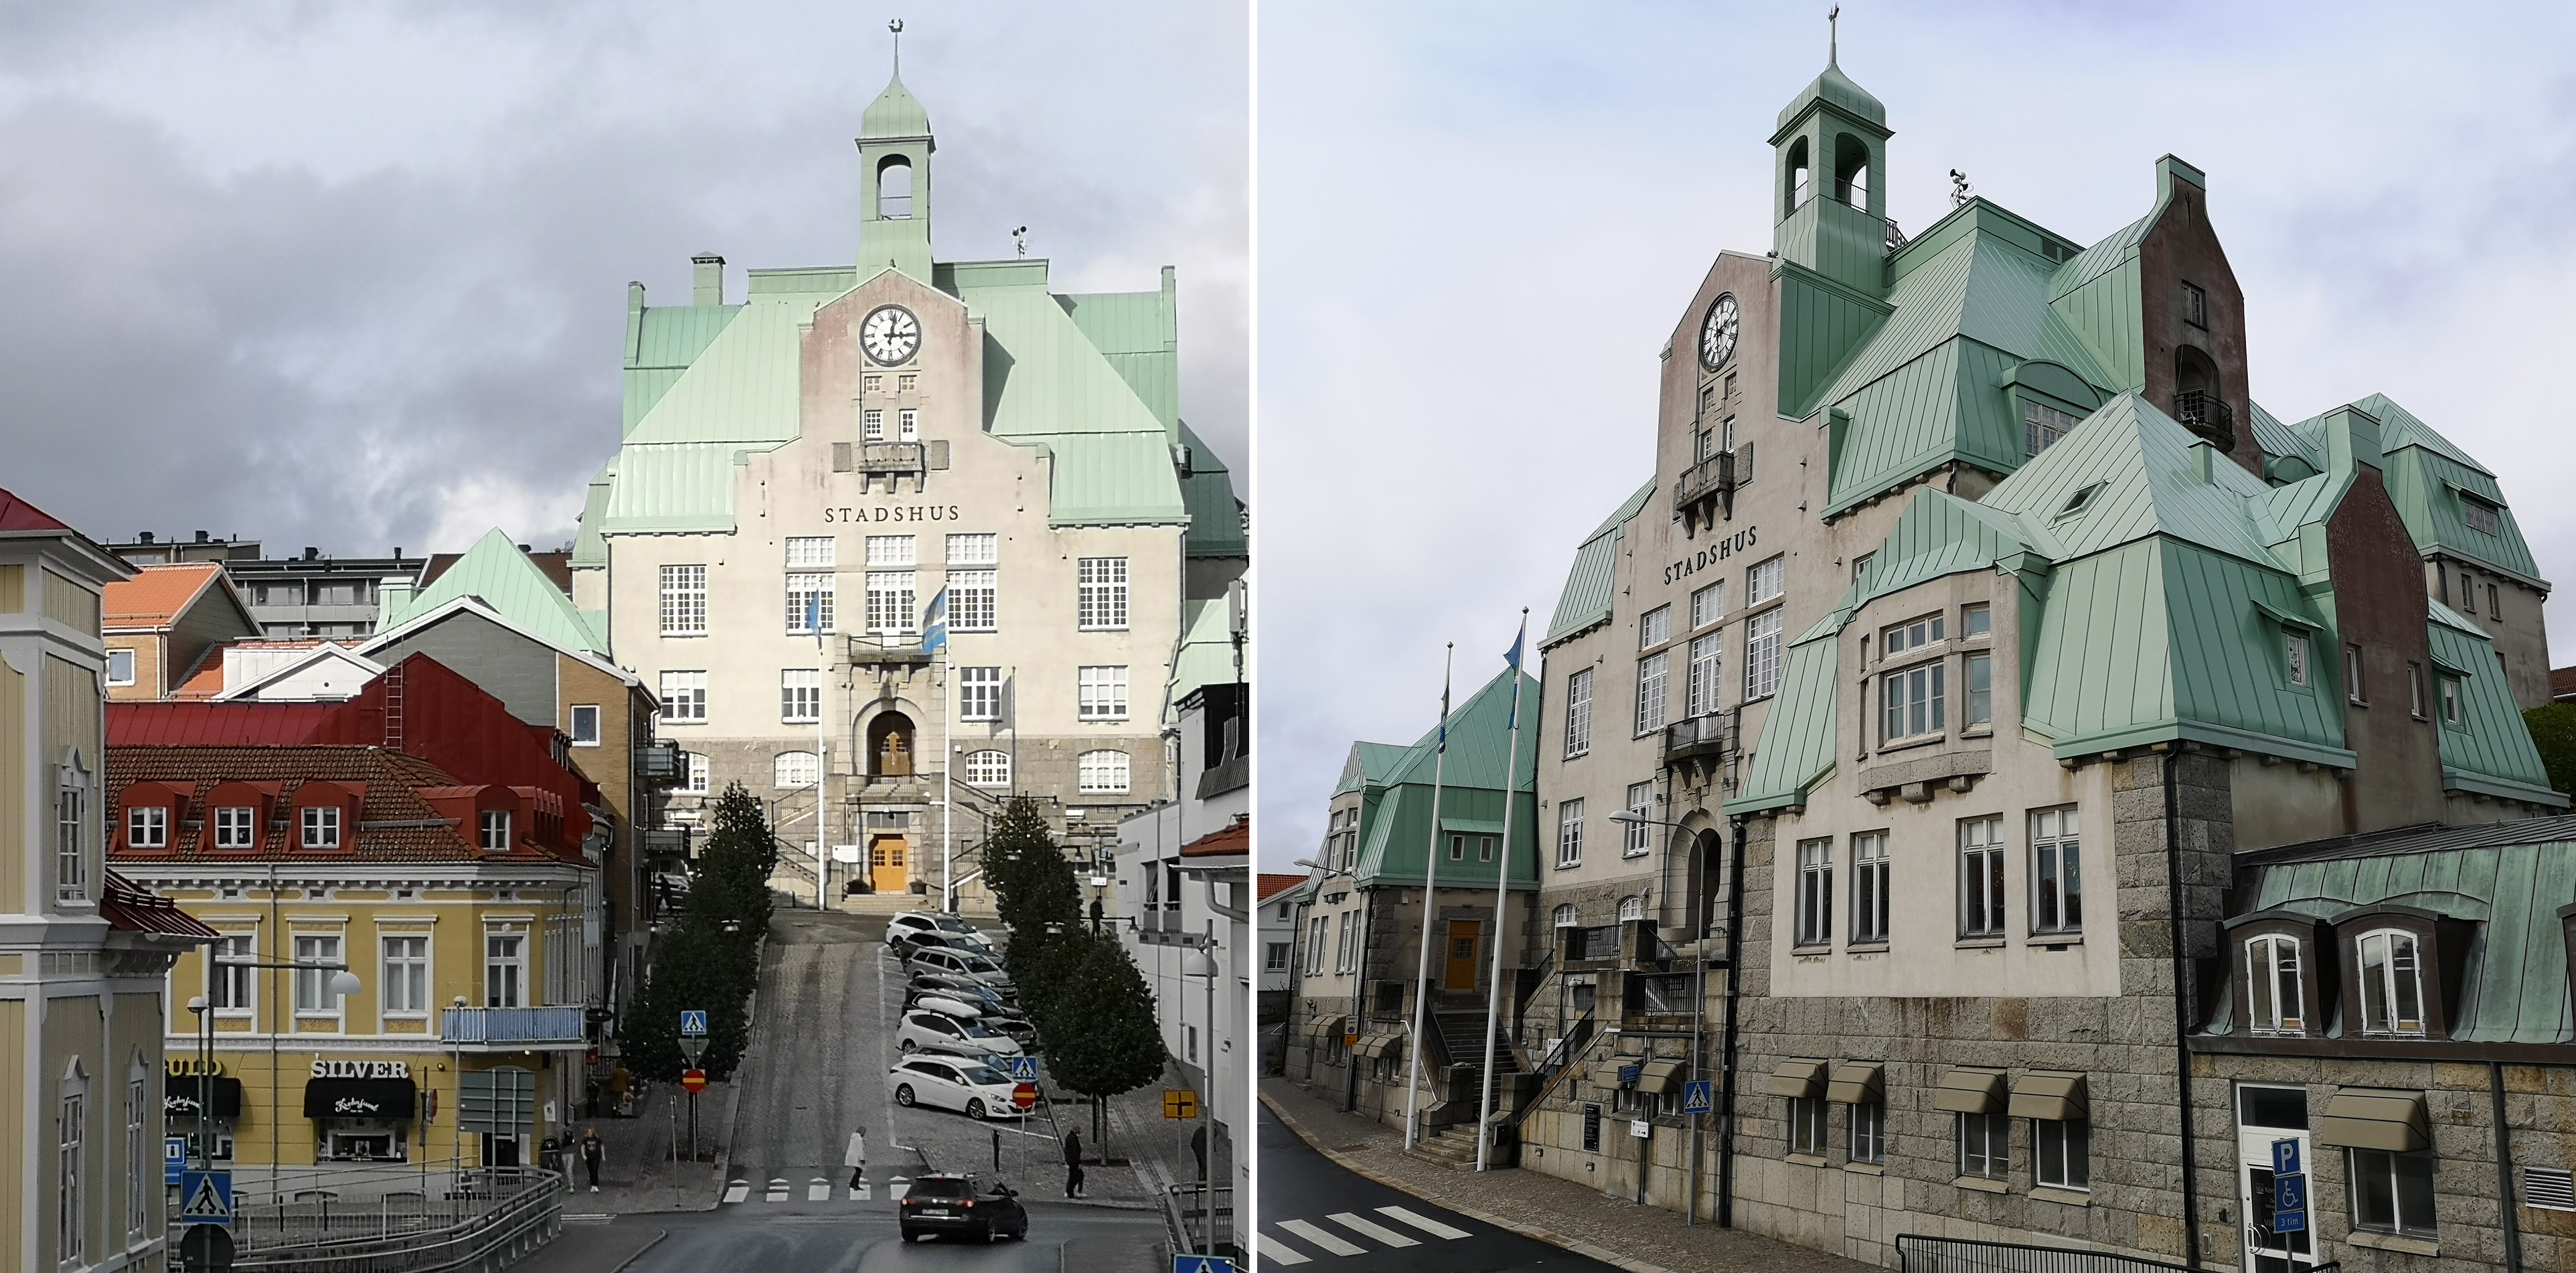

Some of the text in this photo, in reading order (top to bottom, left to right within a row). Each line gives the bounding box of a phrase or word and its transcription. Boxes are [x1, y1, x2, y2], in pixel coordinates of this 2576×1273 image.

[825, 505, 959, 523] STADSHUS
[1664, 525, 1757, 585] STADSHUS
[165, 1058, 222, 1076] ULD
[311, 1059, 408, 1078] SILVER
[2280, 1143, 2293, 1171] P
[2281, 1217, 2298, 1226] 3 tim
